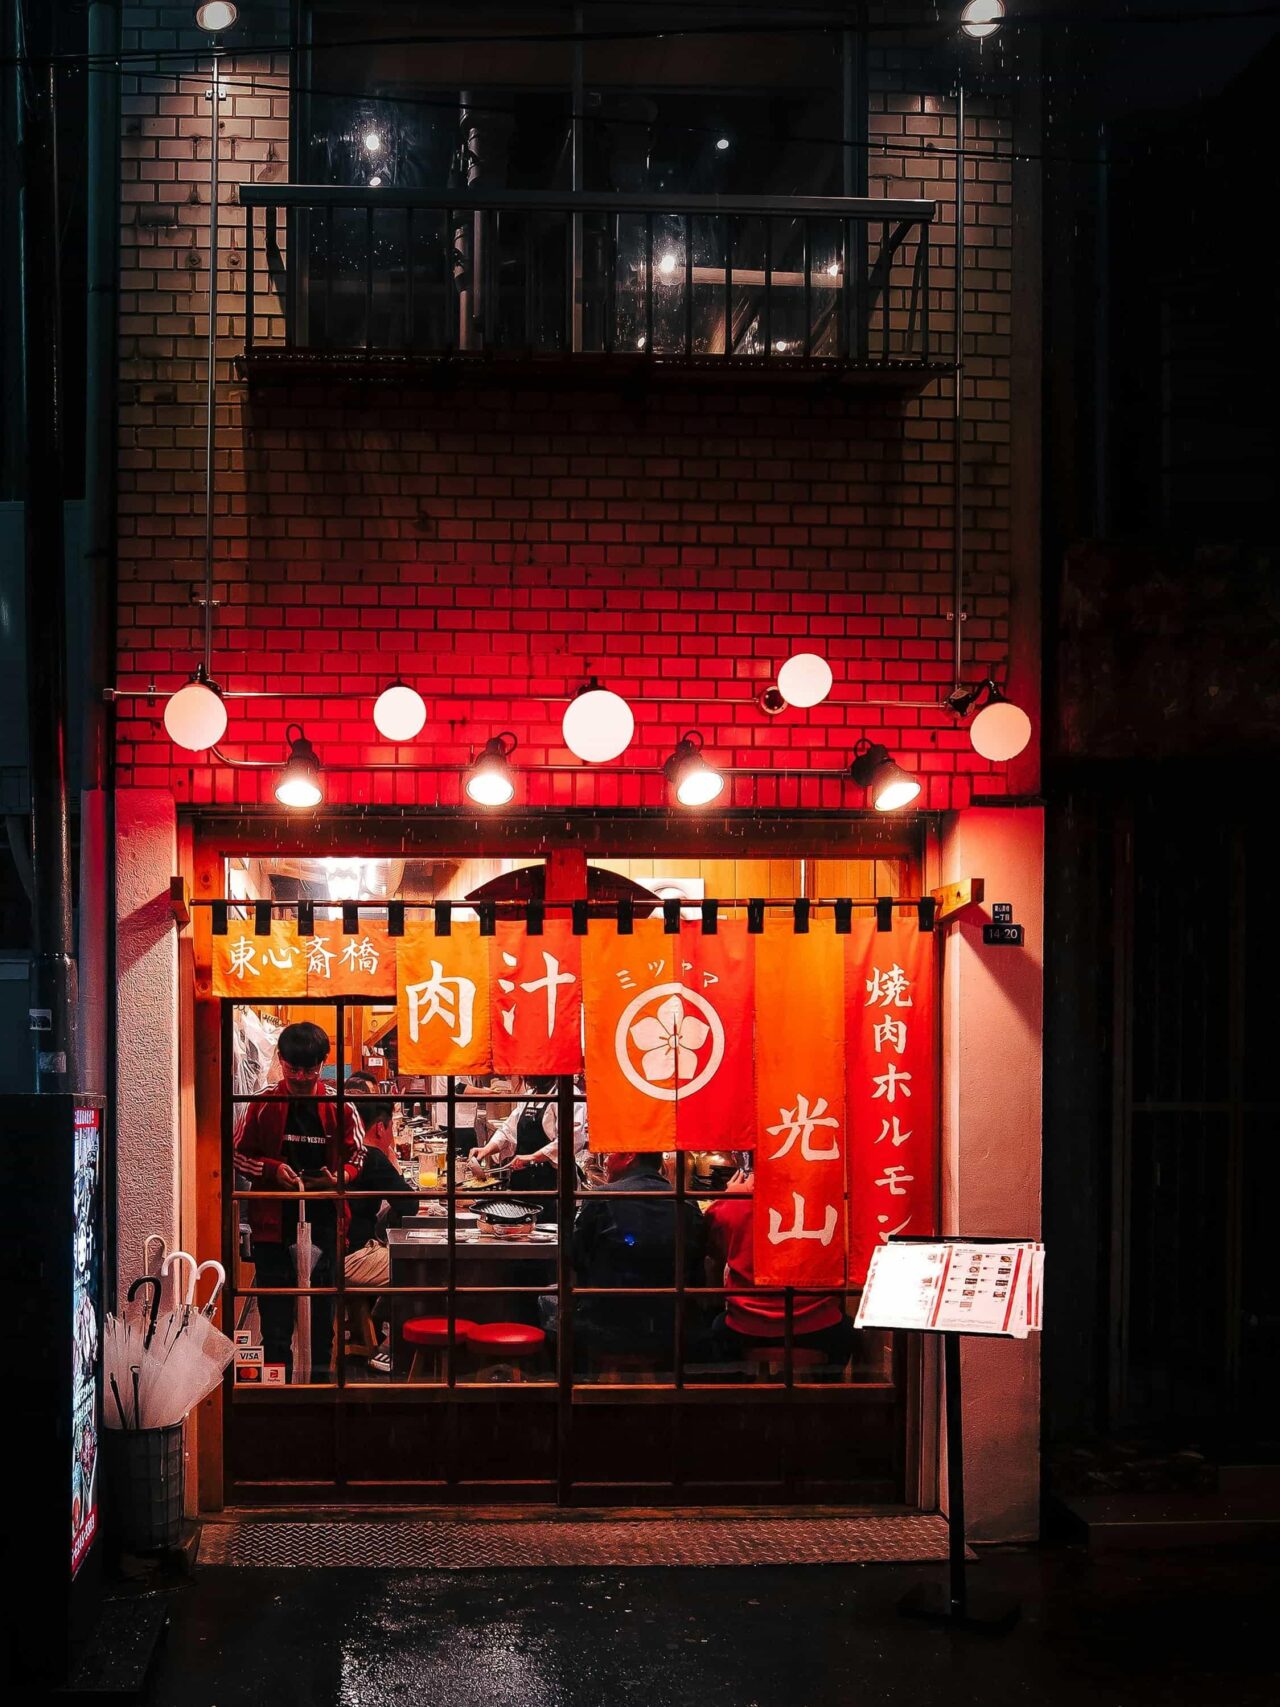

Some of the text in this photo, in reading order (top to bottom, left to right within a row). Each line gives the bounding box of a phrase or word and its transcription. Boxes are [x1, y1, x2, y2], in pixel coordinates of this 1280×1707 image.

[226, 935, 380, 980] 東心斎橋
[407, 950, 578, 1048] 肉汁
[865, 962, 915, 1243] 焼肉ホルモン
[765, 1092, 840, 1247] 光山
[239, 1352, 259, 1360] VISA
